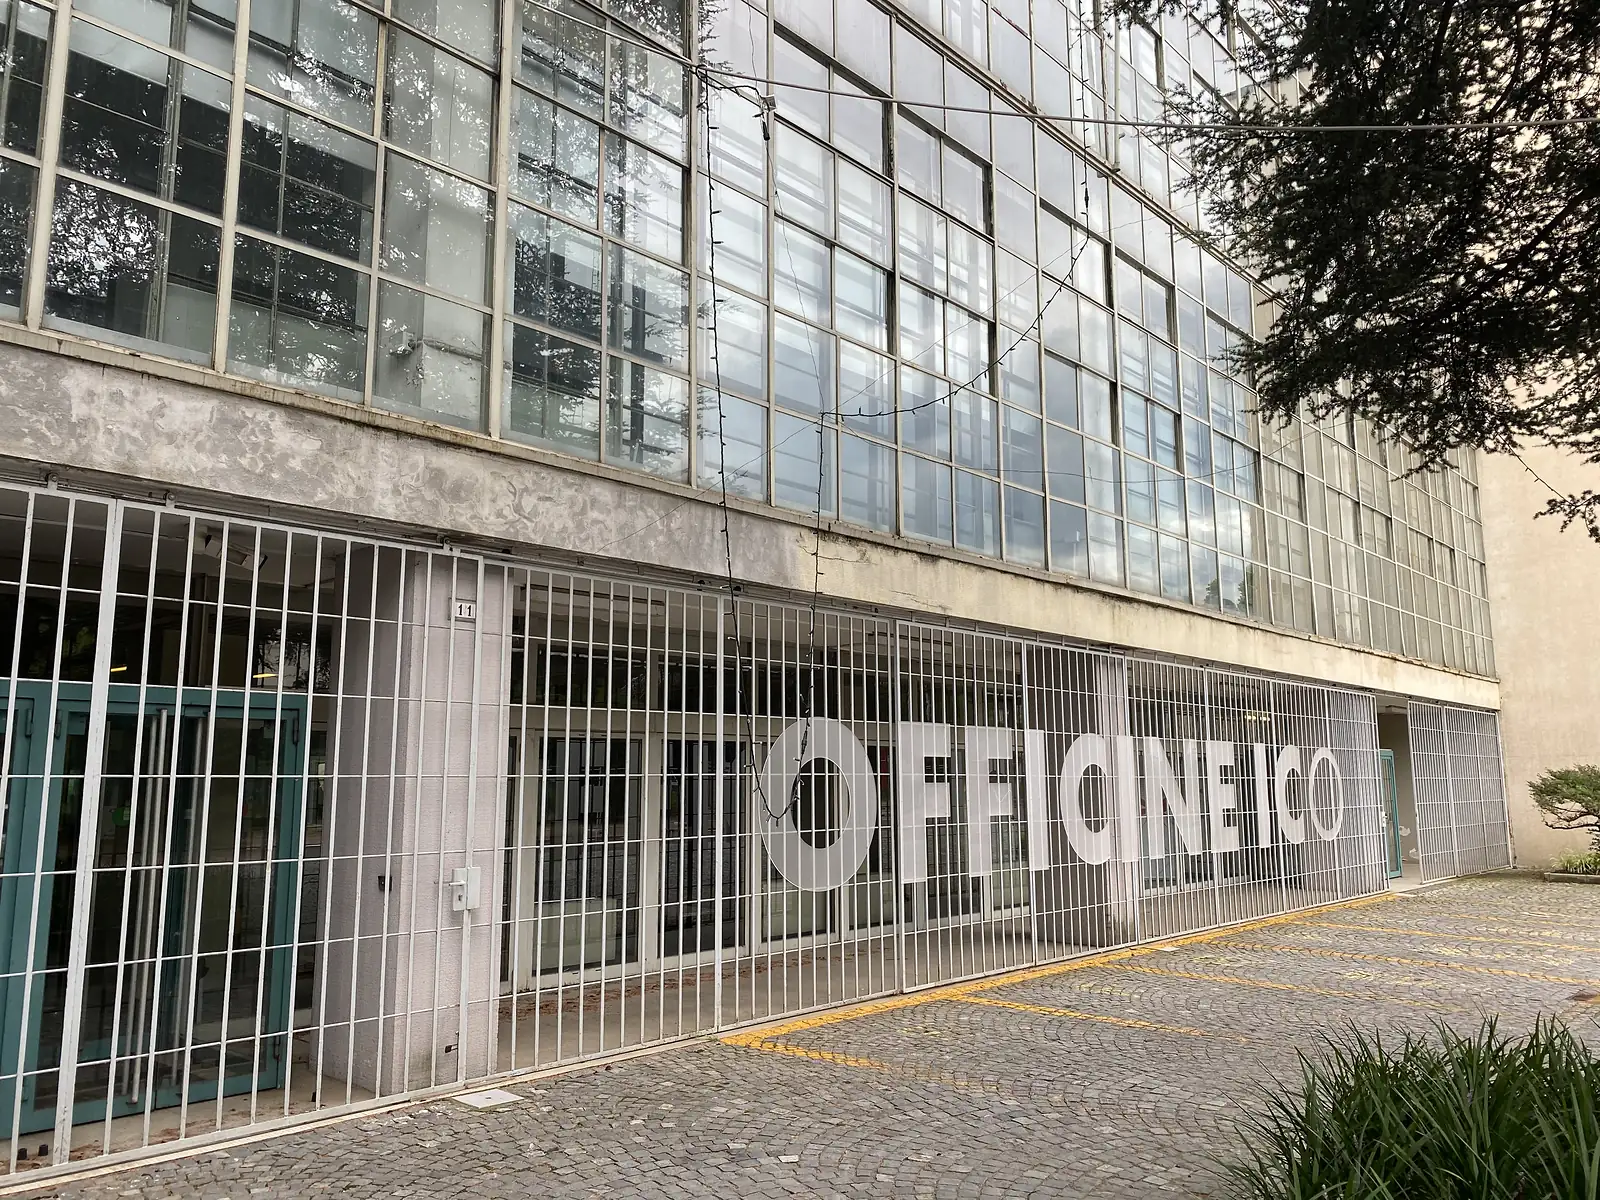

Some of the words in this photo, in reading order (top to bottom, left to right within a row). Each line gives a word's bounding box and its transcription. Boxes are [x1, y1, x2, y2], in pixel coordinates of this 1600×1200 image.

[457, 603, 472, 617] 11
[758, 716, 1240, 892] OFFICINE
[1254, 742, 1344, 848] ICO
